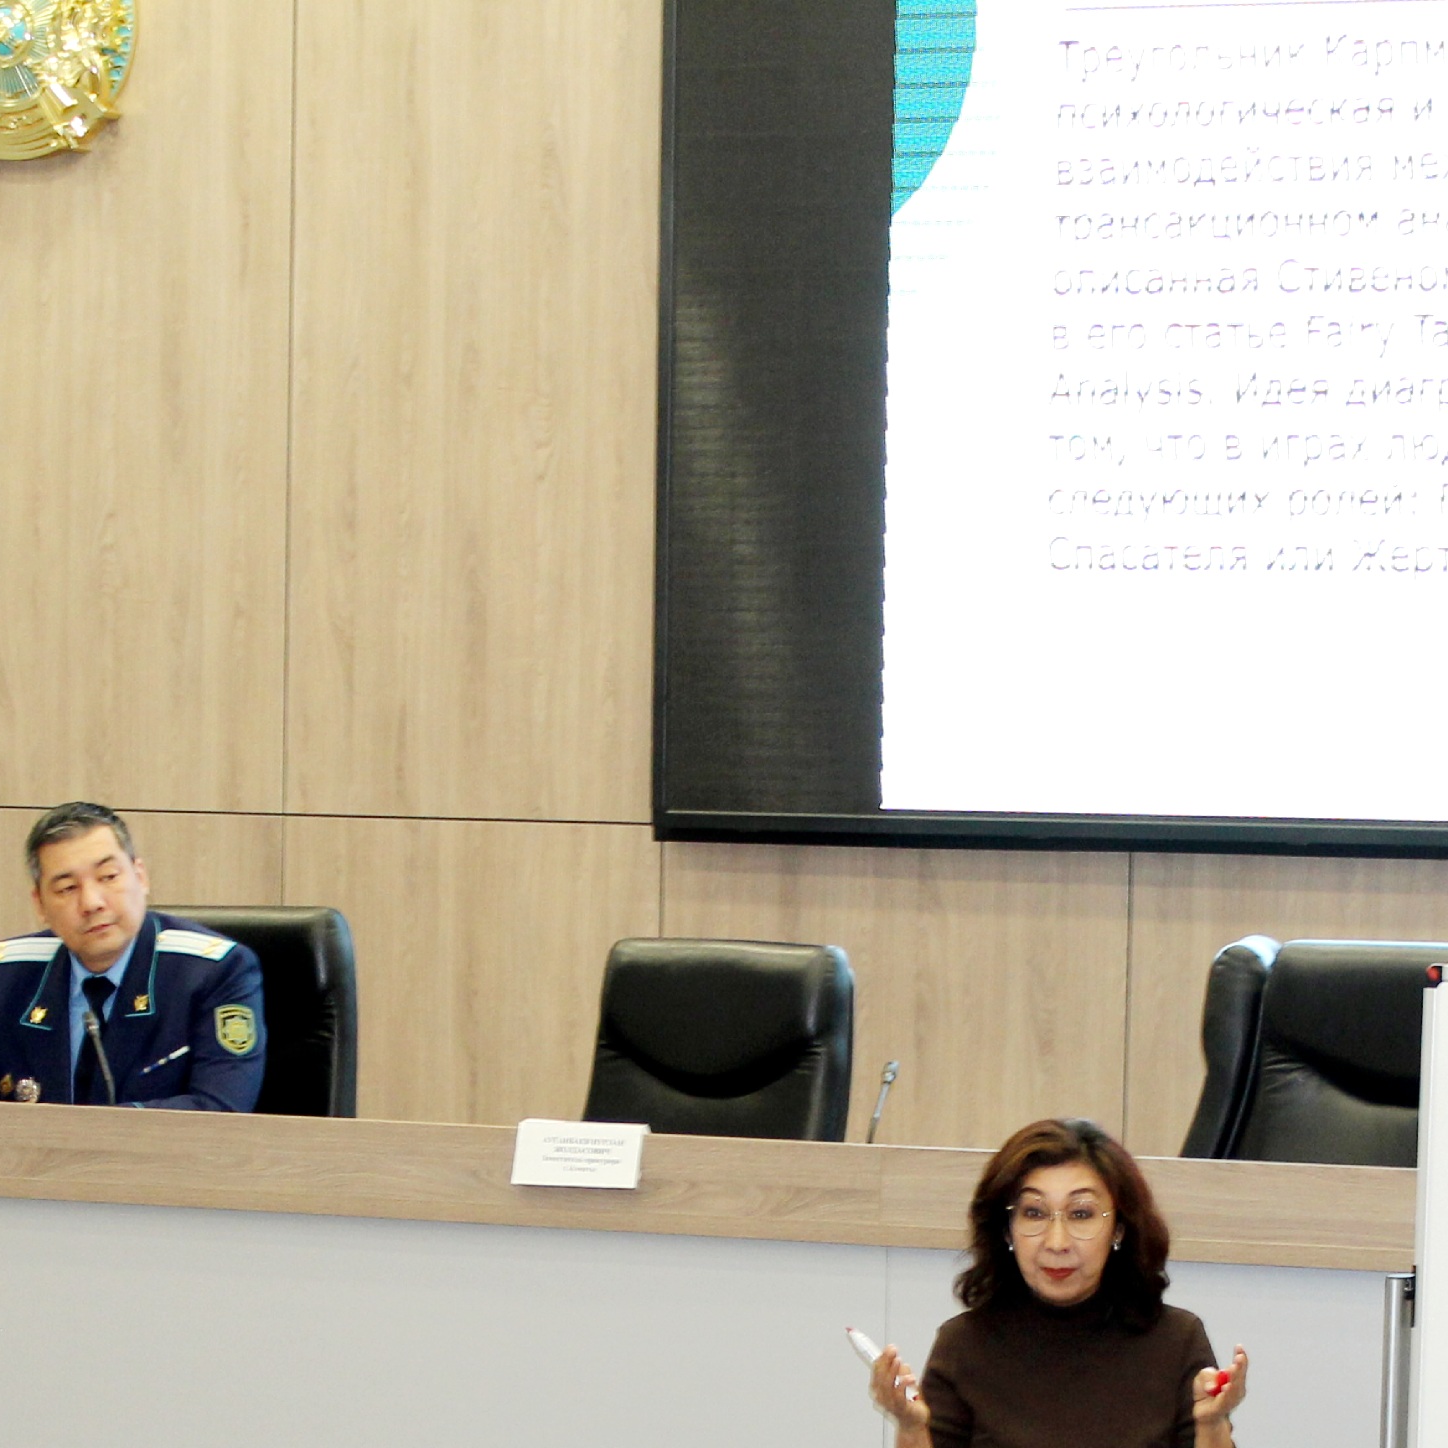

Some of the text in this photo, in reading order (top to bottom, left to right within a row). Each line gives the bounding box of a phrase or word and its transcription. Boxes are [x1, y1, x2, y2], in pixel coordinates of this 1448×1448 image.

[1057, 39, 1305, 84] Треугольник
[1057, 97, 1395, 130] психологическая
[1413, 97, 1433, 122] и
[1056, 146, 1372, 188] взаимодействия
[1053, 267, 1259, 297] описанная
[1052, 324, 1069, 350] в
[1087, 323, 1145, 350] его
[1164, 321, 1287, 349] статье
[1306, 315, 1395, 359] Fairy
[1050, 371, 1212, 410] Analysis.
[1235, 371, 1329, 408] Идея
[1048, 434, 1125, 467] том,
[1145, 434, 1206, 461] что
[1224, 434, 1243, 461] в
[1262, 434, 1367, 468] играх
[1048, 536, 1248, 572] Спасателя
[1266, 546, 1334, 572] или
